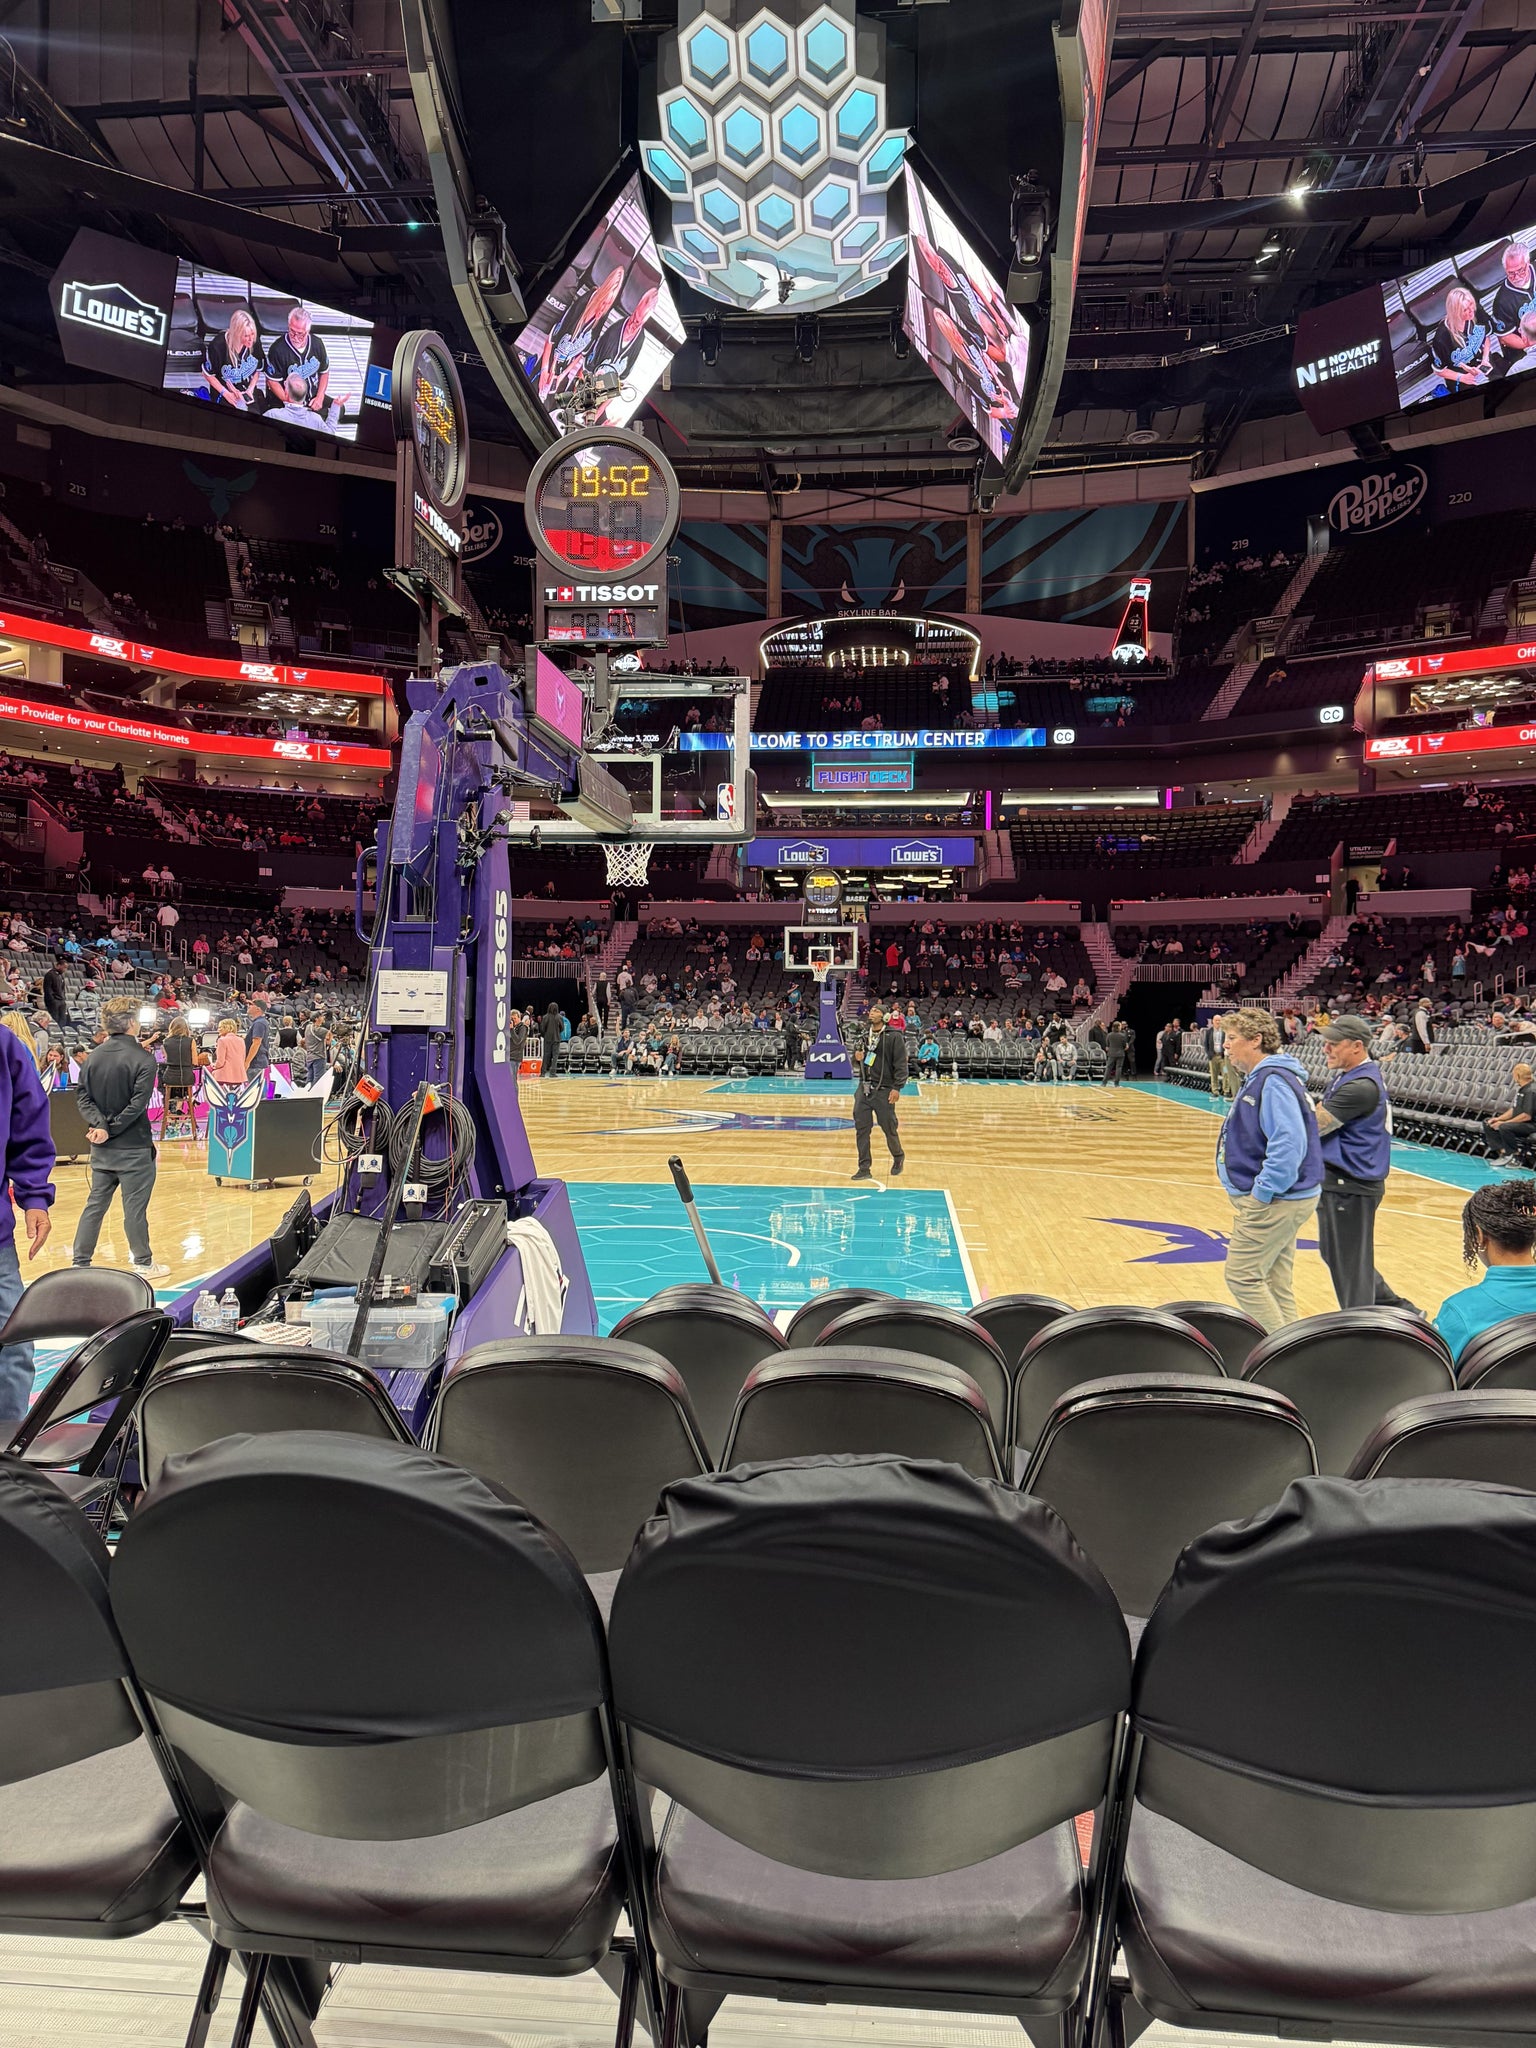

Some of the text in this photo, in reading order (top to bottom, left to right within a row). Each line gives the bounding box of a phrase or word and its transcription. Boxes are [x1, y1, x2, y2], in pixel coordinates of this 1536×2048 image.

[546, 294, 567, 311] LEXUS
[73, 290, 156, 336] LOWE'S
[1329, 340, 1381, 366] NOVANT
[1330, 353, 1378, 378] HEALTH
[365, 398, 393, 411] INSURANC
[573, 465, 650, 497] 19:52
[1362, 472, 1397, 503] Dr
[69, 482, 87, 496] 213
[1339, 476, 1420, 532] Pepper
[1449, 491, 1472, 505] 220
[319, 524, 337, 535] 214
[428, 506, 462, 552] TISSOT
[1232, 538, 1249, 550] 219
[513, 555, 529, 566] 215
[578, 585, 659, 601] TISSOT
[838, 609, 897, 618] SKYLINE BAR
[90, 636, 125, 652] DEX
[240, 664, 276, 676] DEX
[1376, 660, 1410, 673] DEX
[1323, 709, 1340, 720] CC
[21, 705, 65, 722] Provider
[67, 713, 81, 725] for
[84, 719, 106, 729] your
[108, 721, 151, 738] Charlotte
[154, 730, 190, 745] Hornets
[726, 732, 985, 748] WLCOME TO SPECTRUM CENTER
[1056, 732, 1072, 742] CC
[273, 741, 310, 756] DEX
[1370, 738, 1410, 751] DEX
[818, 770, 908, 784] FLIGHT DECK
[897, 849, 938, 862] LOWE'S
[493, 890, 508, 1063] bet365
[810, 1052, 846, 1063] KIA
[530, 1062, 537, 1070] G
